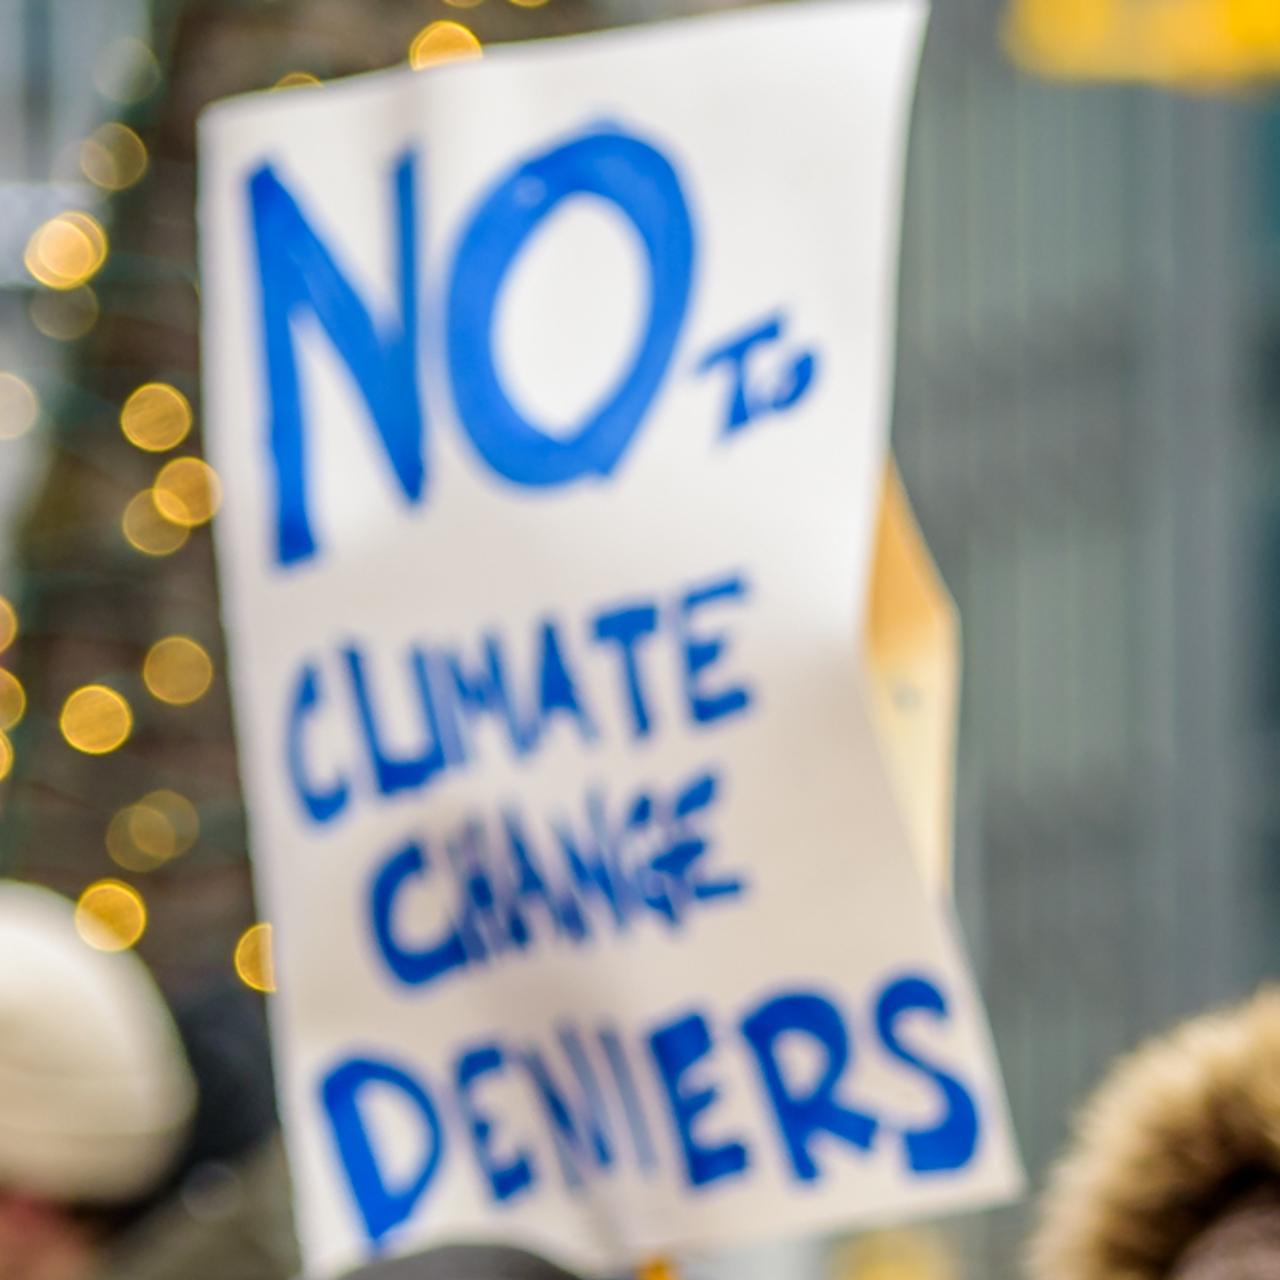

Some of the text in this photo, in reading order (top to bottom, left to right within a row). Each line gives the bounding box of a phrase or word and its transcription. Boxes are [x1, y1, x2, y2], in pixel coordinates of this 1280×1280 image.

[245, 121, 699, 568] NO
[287, 576, 752, 826] CLIMATE
[367, 773, 744, 988] CHANGE
[319, 974, 981, 1253] DENIERS
